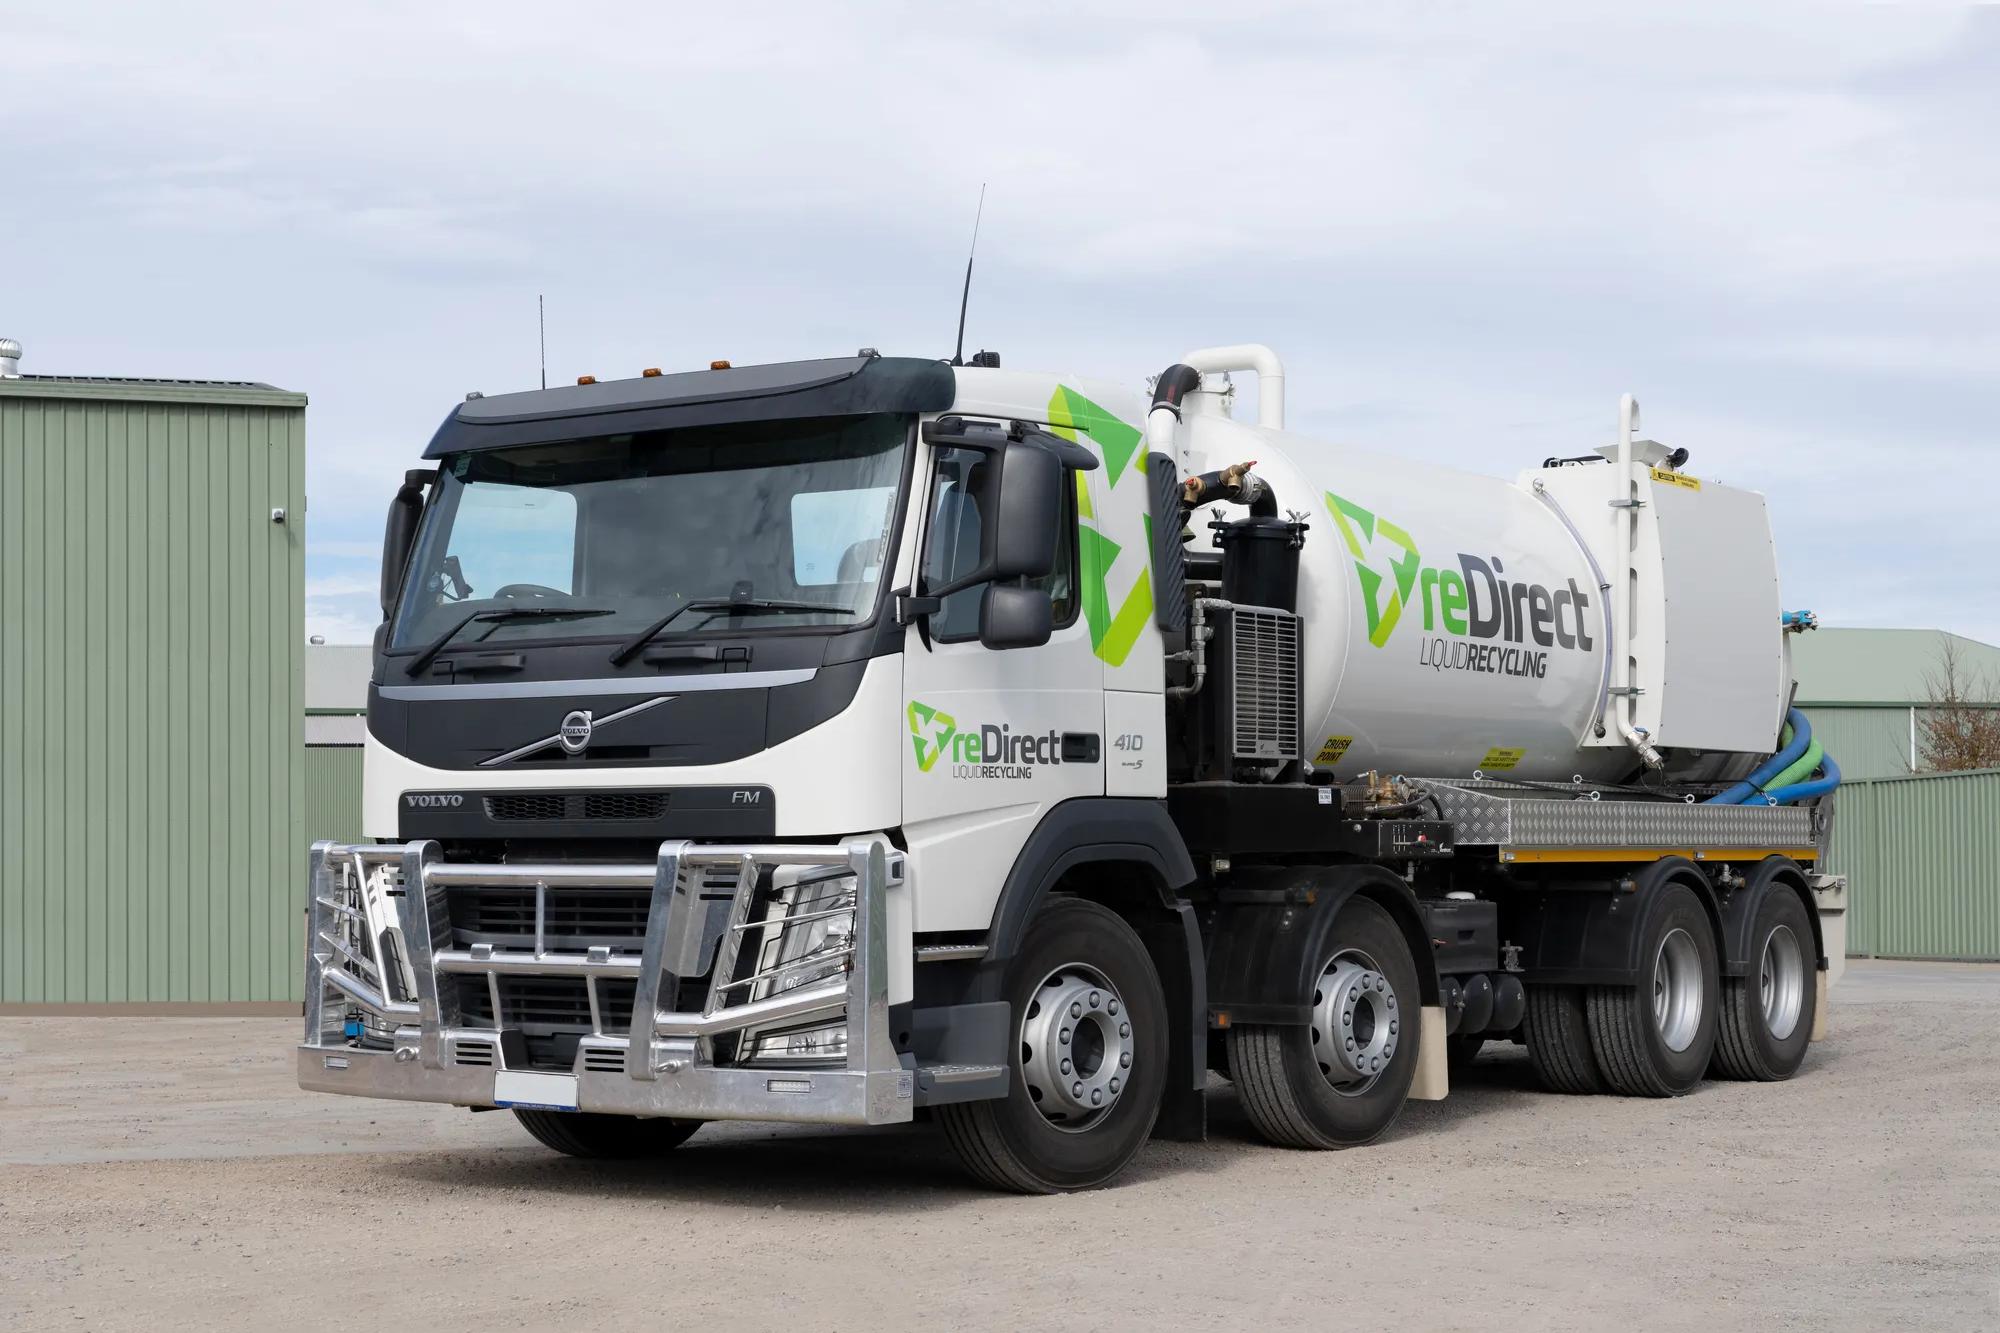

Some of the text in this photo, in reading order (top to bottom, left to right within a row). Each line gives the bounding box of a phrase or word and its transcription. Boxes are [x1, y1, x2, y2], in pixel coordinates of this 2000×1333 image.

[1420, 552, 1593, 652] reDirect
[952, 723, 1061, 765] reDirect
[1114, 734, 1143, 751] 410
[1324, 739, 1352, 750] CRUSH
[1316, 752, 1343, 761] POINT
[405, 794, 464, 807] VOLVO
[731, 791, 761, 804] FM
